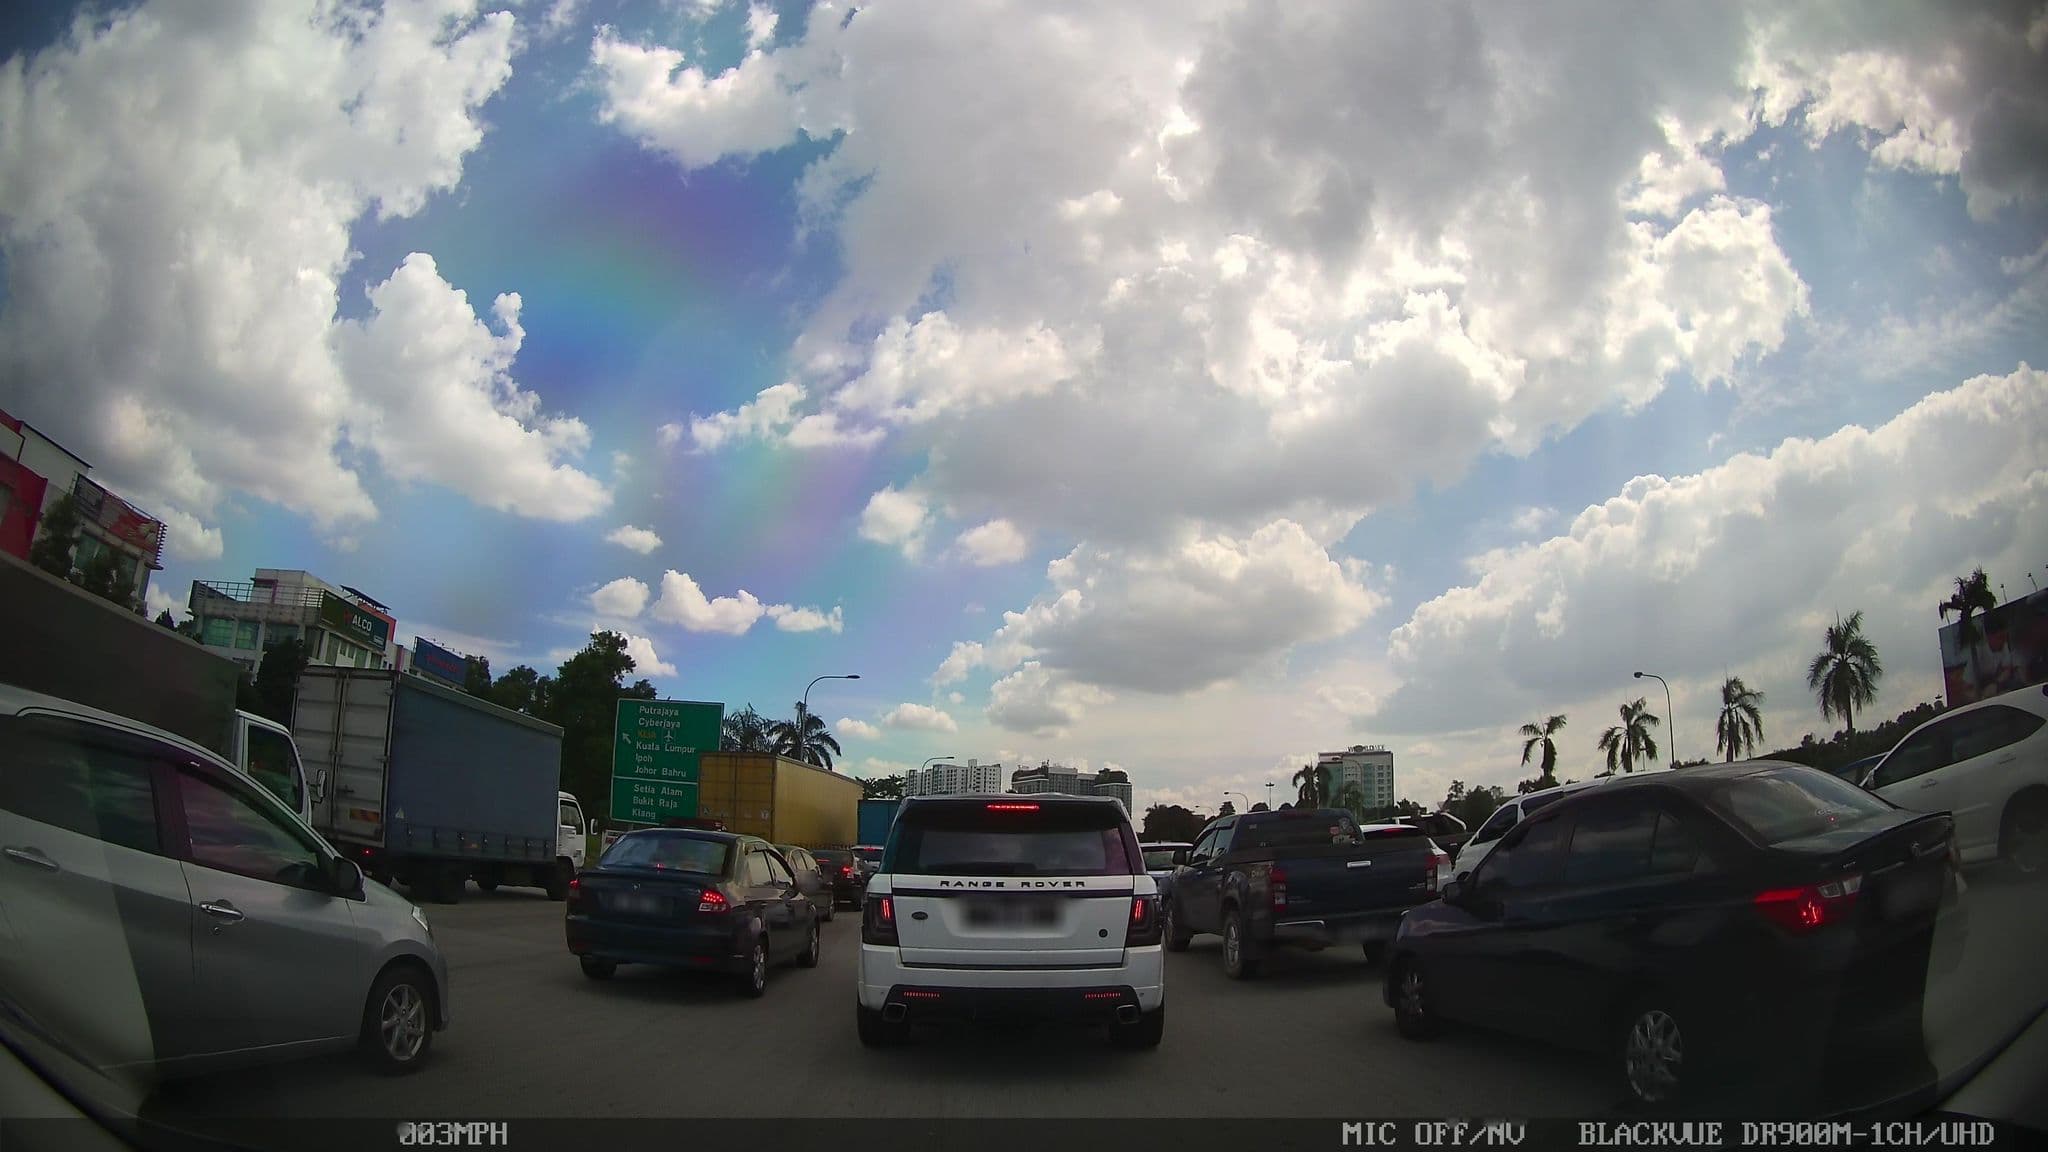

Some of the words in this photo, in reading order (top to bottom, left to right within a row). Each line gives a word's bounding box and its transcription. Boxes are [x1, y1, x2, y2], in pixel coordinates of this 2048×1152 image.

[352, 614, 373, 632] ALCO
[639, 705, 679, 717] Putrajaya
[638, 717, 681, 729] Cyberjaya
[636, 741, 660, 751] Kuala
[664, 743, 696, 754] Lumpur
[635, 753, 653, 763] Ipoh
[635, 765, 657, 775] Johor
[662, 767, 687, 777] Bahru
[634, 784, 656, 794] Setia
[661, 787, 682, 796] Alam
[633, 796, 654, 806] Bukit
[659, 799, 678, 809] Raja
[632, 808, 656, 819] Klang
[939, 880, 1005, 888] RANGE
